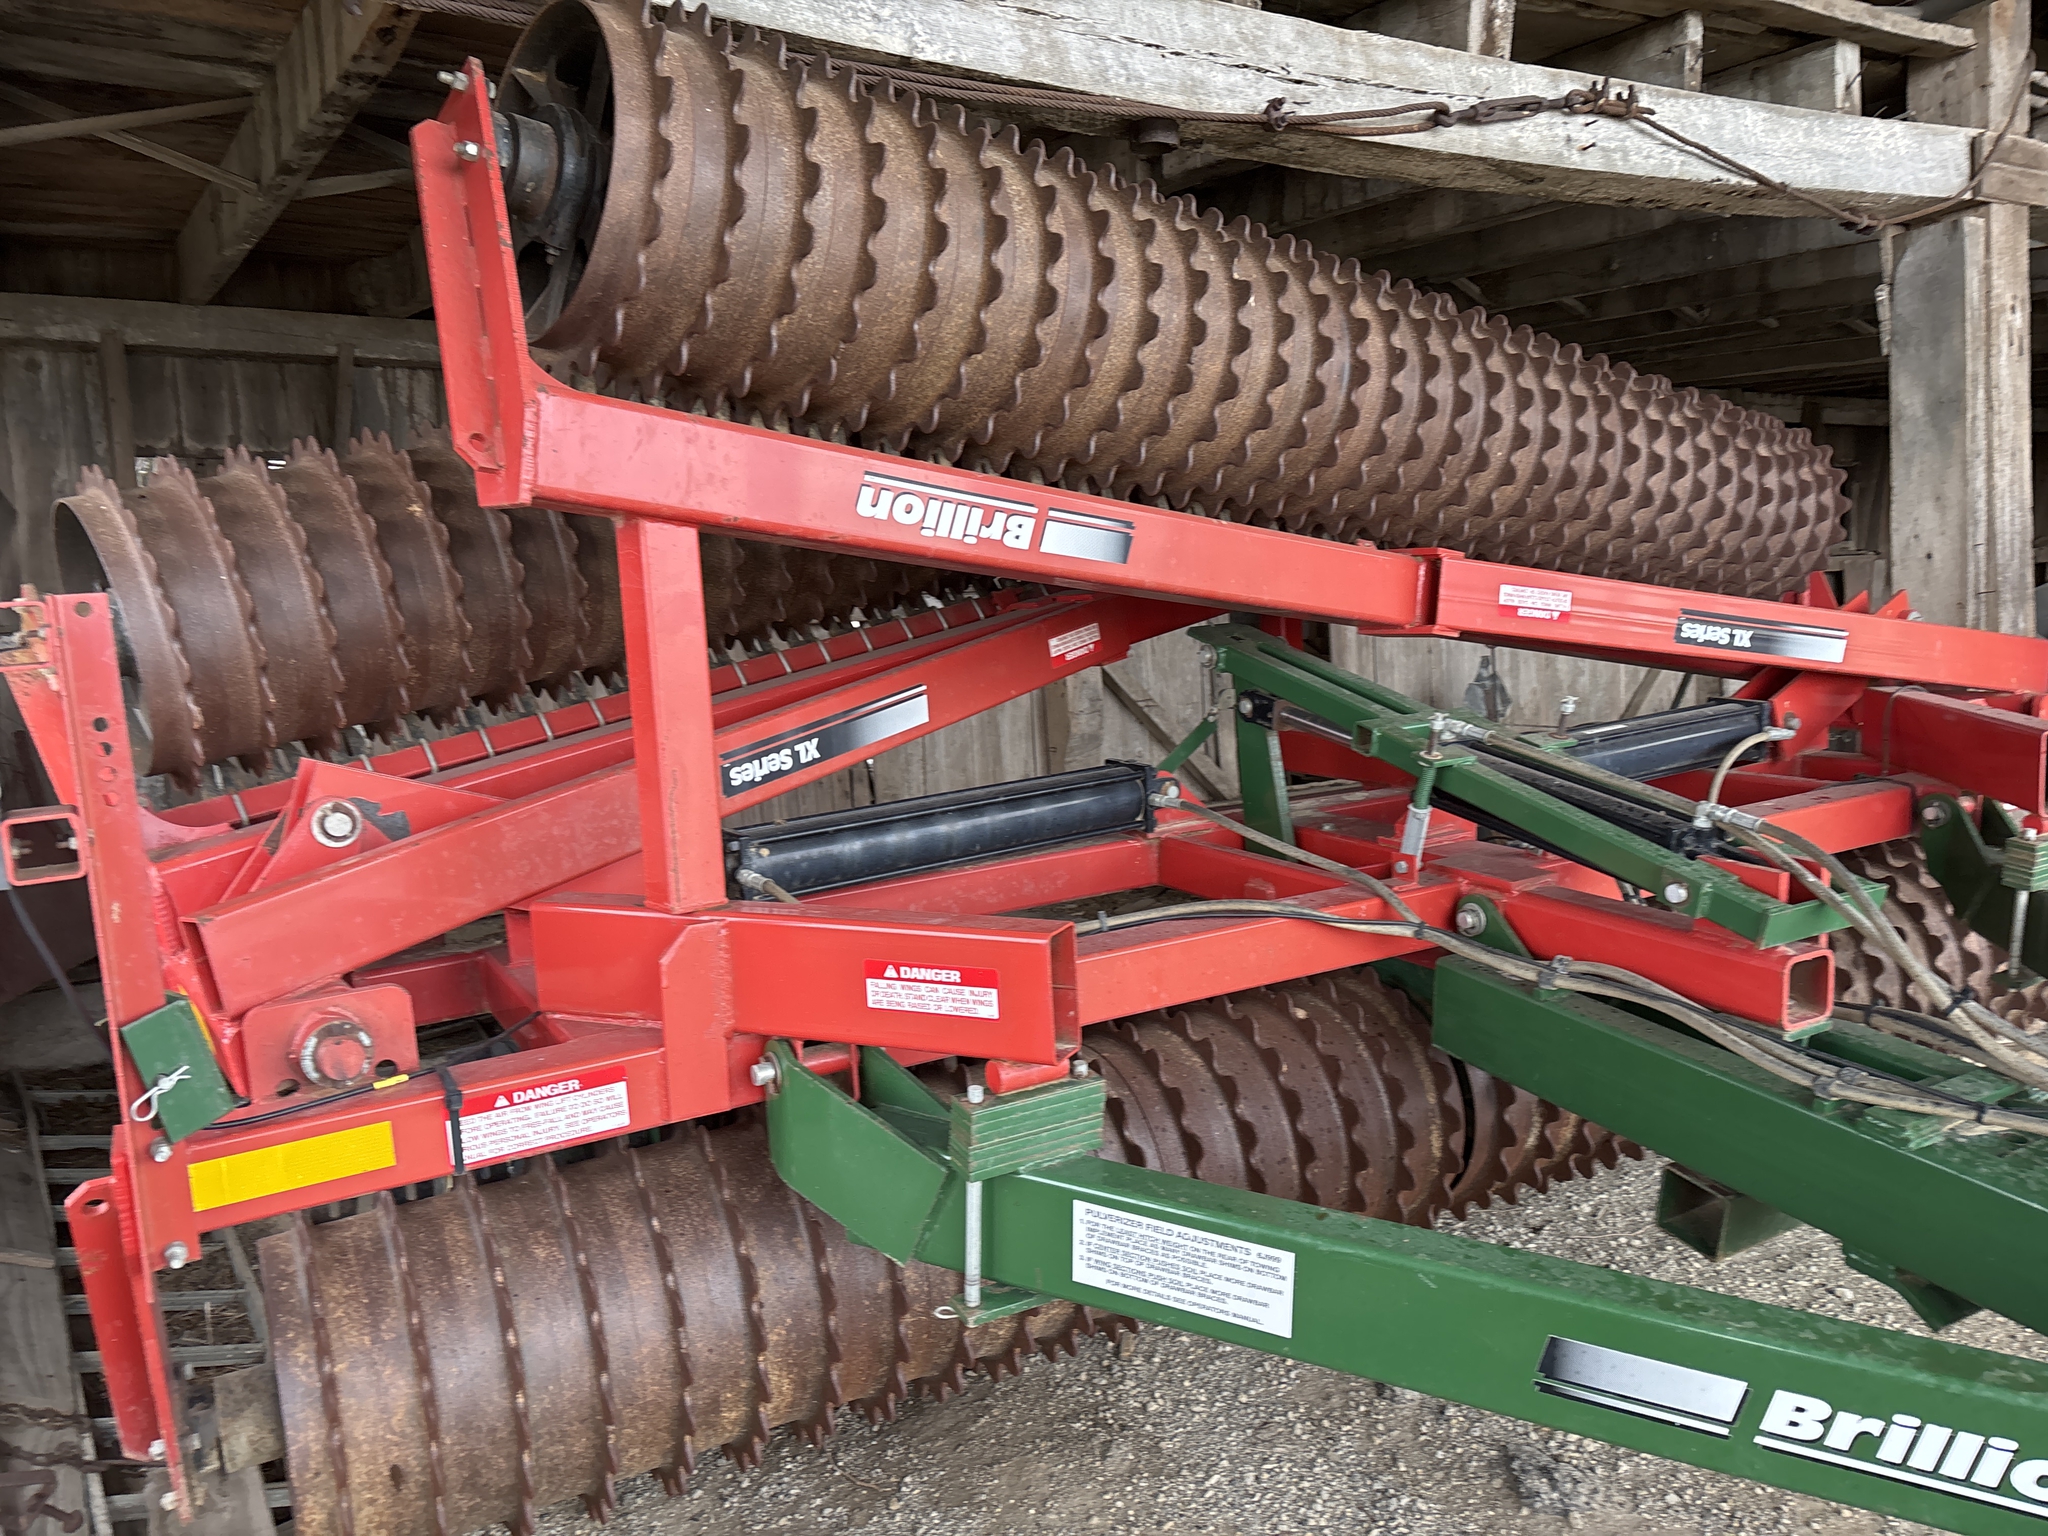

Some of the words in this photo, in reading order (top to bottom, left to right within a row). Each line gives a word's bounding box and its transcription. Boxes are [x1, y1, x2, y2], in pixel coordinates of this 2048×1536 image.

[855, 484, 1036, 551] Brillion
[1680, 622, 1731, 646] Series
[1731, 628, 1754, 648] XL
[794, 738, 821, 764] XL
[729, 748, 793, 786] Series
[899, 965, 961, 983] DANGER
[900, 983, 921, 991] WINGS
[924, 985, 939, 993] CAN
[942, 987, 965, 995] CAUSE
[969, 989, 992, 997] INJURY
[951, 997, 970, 1005] WHEN
[972, 998, 993, 1006] WINGS
[512, 1079, 580, 1104] DANGER
[1085, 1208, 1143, 1229] PULVERIZER
[1145, 1222, 1174, 1237] FIELD
[1175, 1230, 1251, 1256] ADJUSTMENTS
